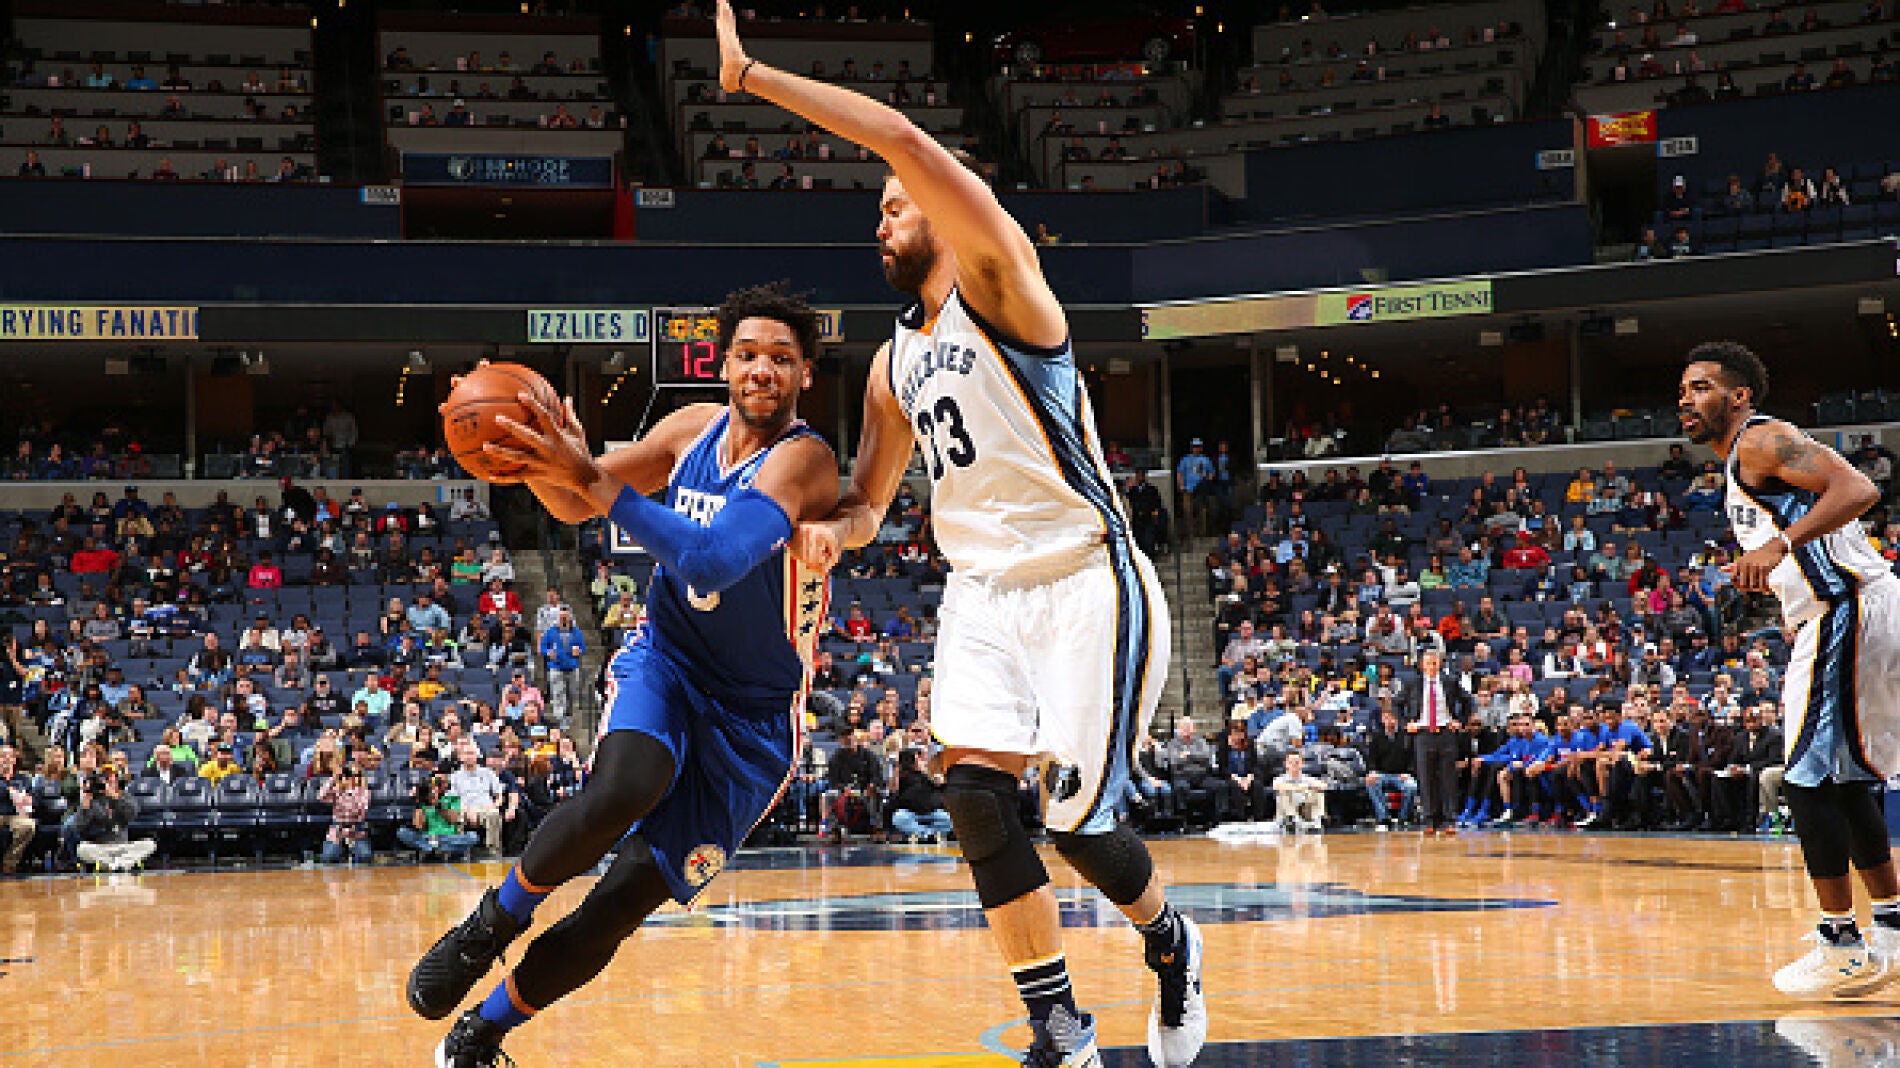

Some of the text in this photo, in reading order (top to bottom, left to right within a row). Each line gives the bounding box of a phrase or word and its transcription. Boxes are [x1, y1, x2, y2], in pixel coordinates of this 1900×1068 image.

[1375, 296, 1421, 314] FIRST
[2, 309, 83, 336] RYING
[530, 312, 623, 339] IZZLIES
[682, 341, 716, 378] 12
